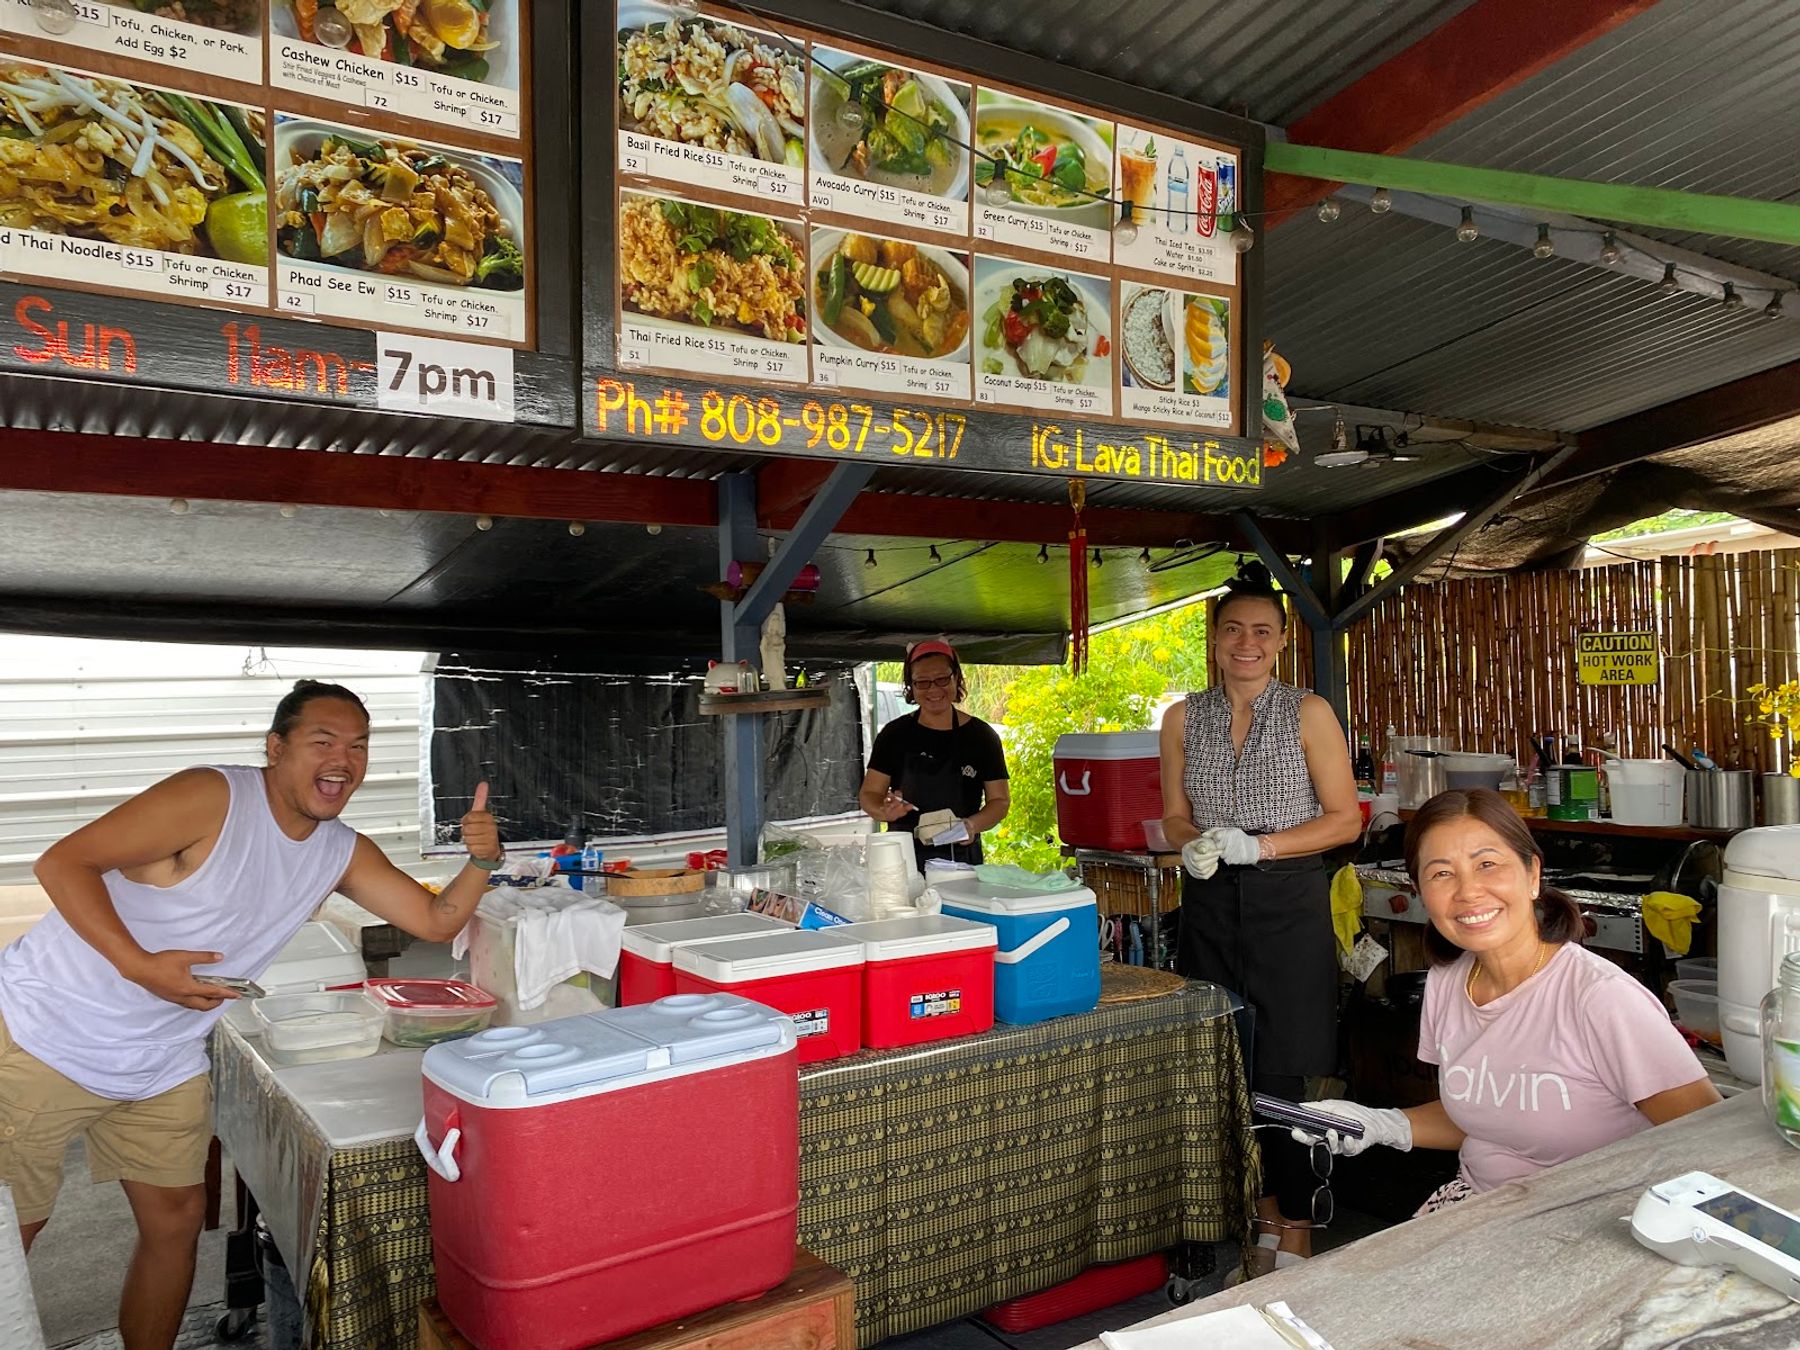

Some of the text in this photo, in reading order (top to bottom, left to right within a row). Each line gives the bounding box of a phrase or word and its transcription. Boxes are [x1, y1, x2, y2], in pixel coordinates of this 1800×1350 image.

[115, 35, 187, 60] Add Egg $2
[203, 37, 216, 48] or
[281, 46, 330, 69] Cashew
[336, 59, 384, 81] Chicken
[395, 71, 419, 88] $15
[430, 82, 453, 96] Tofu
[456, 90, 466, 98] or
[373, 96, 388, 108] 72
[433, 100, 503, 125] Shrimp $17
[627, 136, 651, 152] Basil
[654, 142, 680, 159] Fried
[683, 149, 704, 162] Rice
[705, 153, 724, 167] $15
[730, 160, 746, 172] Tofu
[732, 175, 788, 194] Shrimp $17
[816, 176, 851, 193] Avocado
[853, 183, 877, 201] Curry
[879, 189, 895, 202] $15
[901, 195, 917, 206] Tofu
[812, 195, 830, 206] AVO
[903, 208, 949, 226] Shrimp $17
[983, 210, 1006, 223] Green
[1007, 215, 1028, 230] Curry
[1030, 220, 1043, 231] $15
[1050, 237, 1088, 254] Shrimp $17
[1155, 236, 1168, 246] Thai
[19, 233, 53, 250] Thai
[60, 240, 122, 260] Noodles
[125, 252, 154, 268] $15
[165, 257, 191, 273] Tofu
[195, 263, 207, 274] or
[1165, 249, 1184, 260] Water
[1154, 257, 1168, 267] Coke
[1177, 262, 1195, 273] Sprite
[169, 274, 252, 299] Shrimp $17
[290, 271, 322, 288] Phad
[327, 277, 352, 292] See
[357, 281, 377, 296] Ew
[388, 286, 412, 301] $15
[420, 292, 444, 307] Tofu
[447, 298, 458, 307] or
[286, 296, 301, 307] 42
[424, 308, 489, 329] Shrimp $17
[14, 295, 138, 375] Sun
[383, 348, 496, 406] 7pm
[629, 329, 652, 343] Thai
[655, 332, 682, 347] Fried
[685, 336, 706, 350] Rice
[708, 340, 726, 352] $15
[731, 343, 749, 356] Tofu
[751, 348, 759, 356] or
[733, 357, 784, 373] Shrimp $17
[820, 352, 853, 368] Pumpkin
[856, 358, 879, 373] Curry
[881, 362, 897, 373] $15
[904, 365, 918, 375] Tofu
[819, 373, 829, 383] 36
[907, 379, 950, 393] Shrimp $17
[984, 375, 1012, 388] Coconut
[1014, 379, 1032, 392] Soup
[1033, 381, 1047, 391] $15
[1055, 395, 1093, 408] Shrimp $17
[1159, 396, 1177, 407] Sticky
[1178, 398, 1190, 407] Rice
[596, 379, 966, 460] Ph# 808-987-5217
[1153, 405, 1170, 416] Sticky
[1171, 408, 1184, 416] Rice
[1195, 410, 1216, 419] Coconut
[1076, 428, 1141, 477] Lava
[1145, 434, 1198, 481] Thai
[1204, 440, 1260, 486] Food
[1582, 635, 1653, 652] CAUTION
[1582, 654, 1652, 667] HOT WORK
[1600, 669, 1635, 681] AREA
